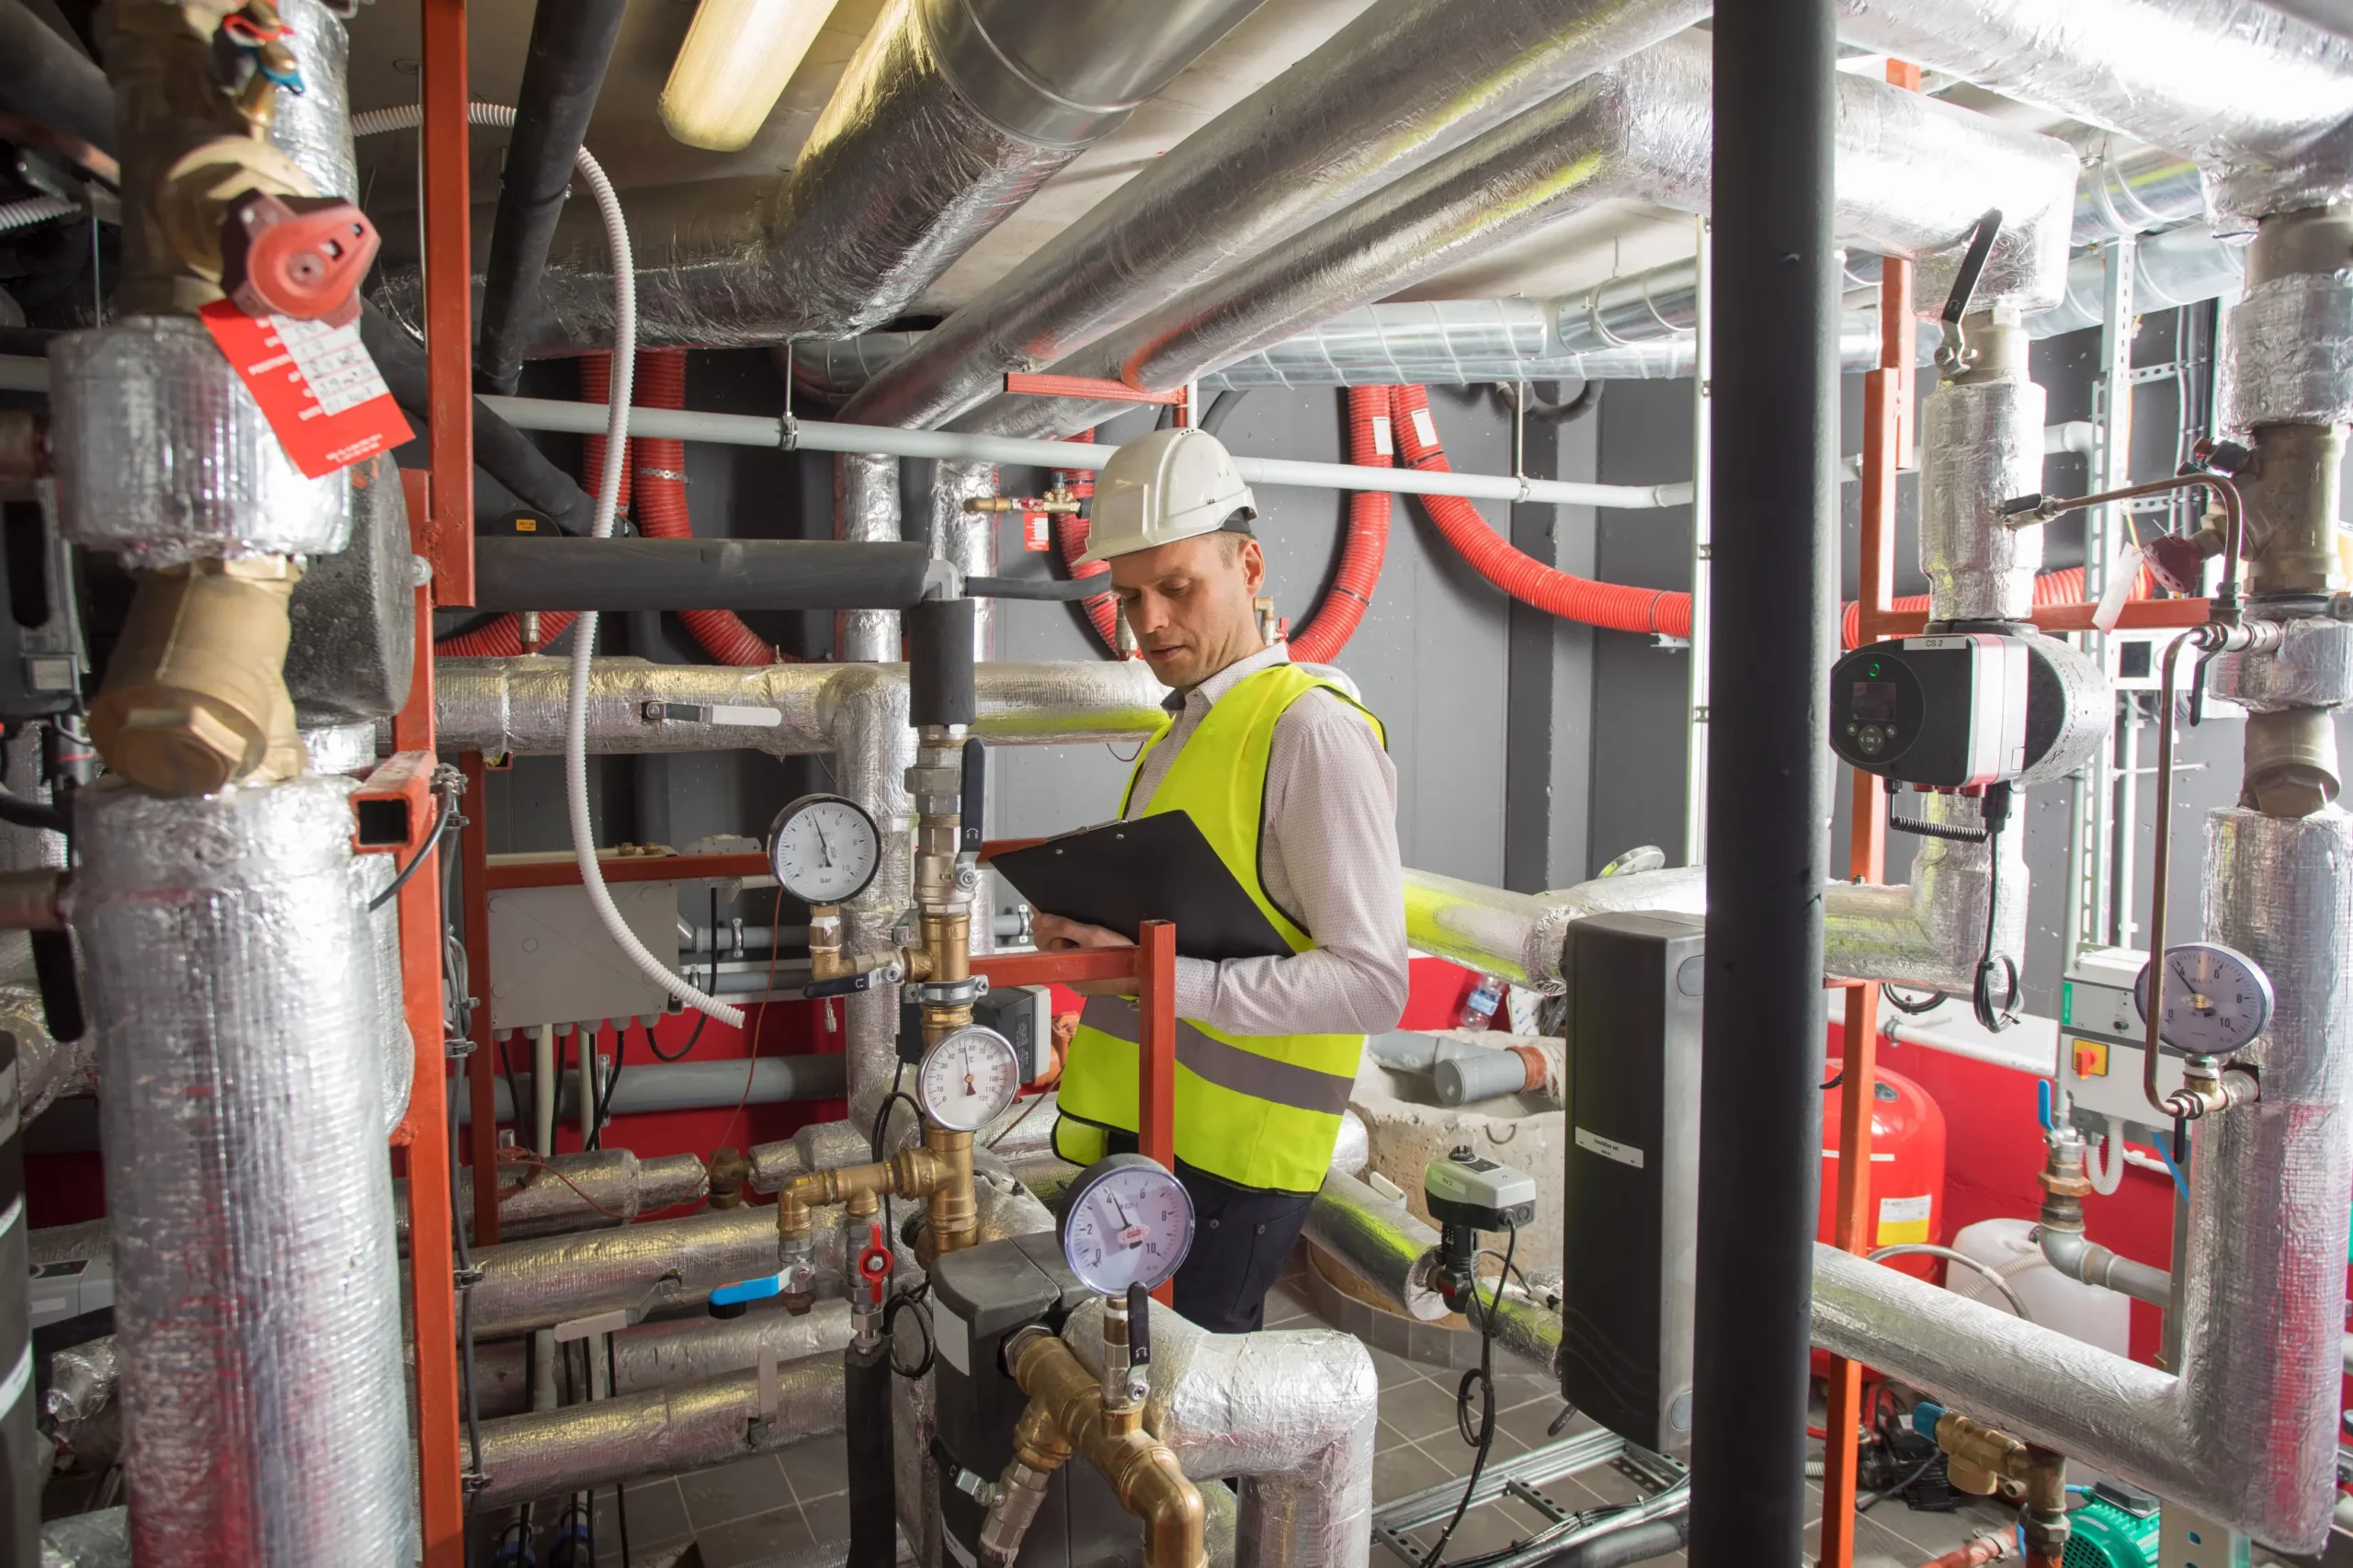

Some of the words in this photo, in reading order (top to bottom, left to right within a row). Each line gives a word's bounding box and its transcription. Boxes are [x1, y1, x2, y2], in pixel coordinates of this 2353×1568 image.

[2180, 967, 2185, 975] 4
[2214, 969, 2219, 979] 6
[2236, 993, 2242, 1003] 8
[2168, 1009, 2173, 1018] 0
[2220, 1017, 2230, 1028] 10
[1106, 1193, 1112, 1204] 4
[1140, 1189, 1145, 1199] 6
[1161, 1210, 1166, 1221] 8
[1087, 1224, 1092, 1235] 2
[1146, 1242, 1156, 1253] 10
[1096, 1249, 1101, 1260] 0
